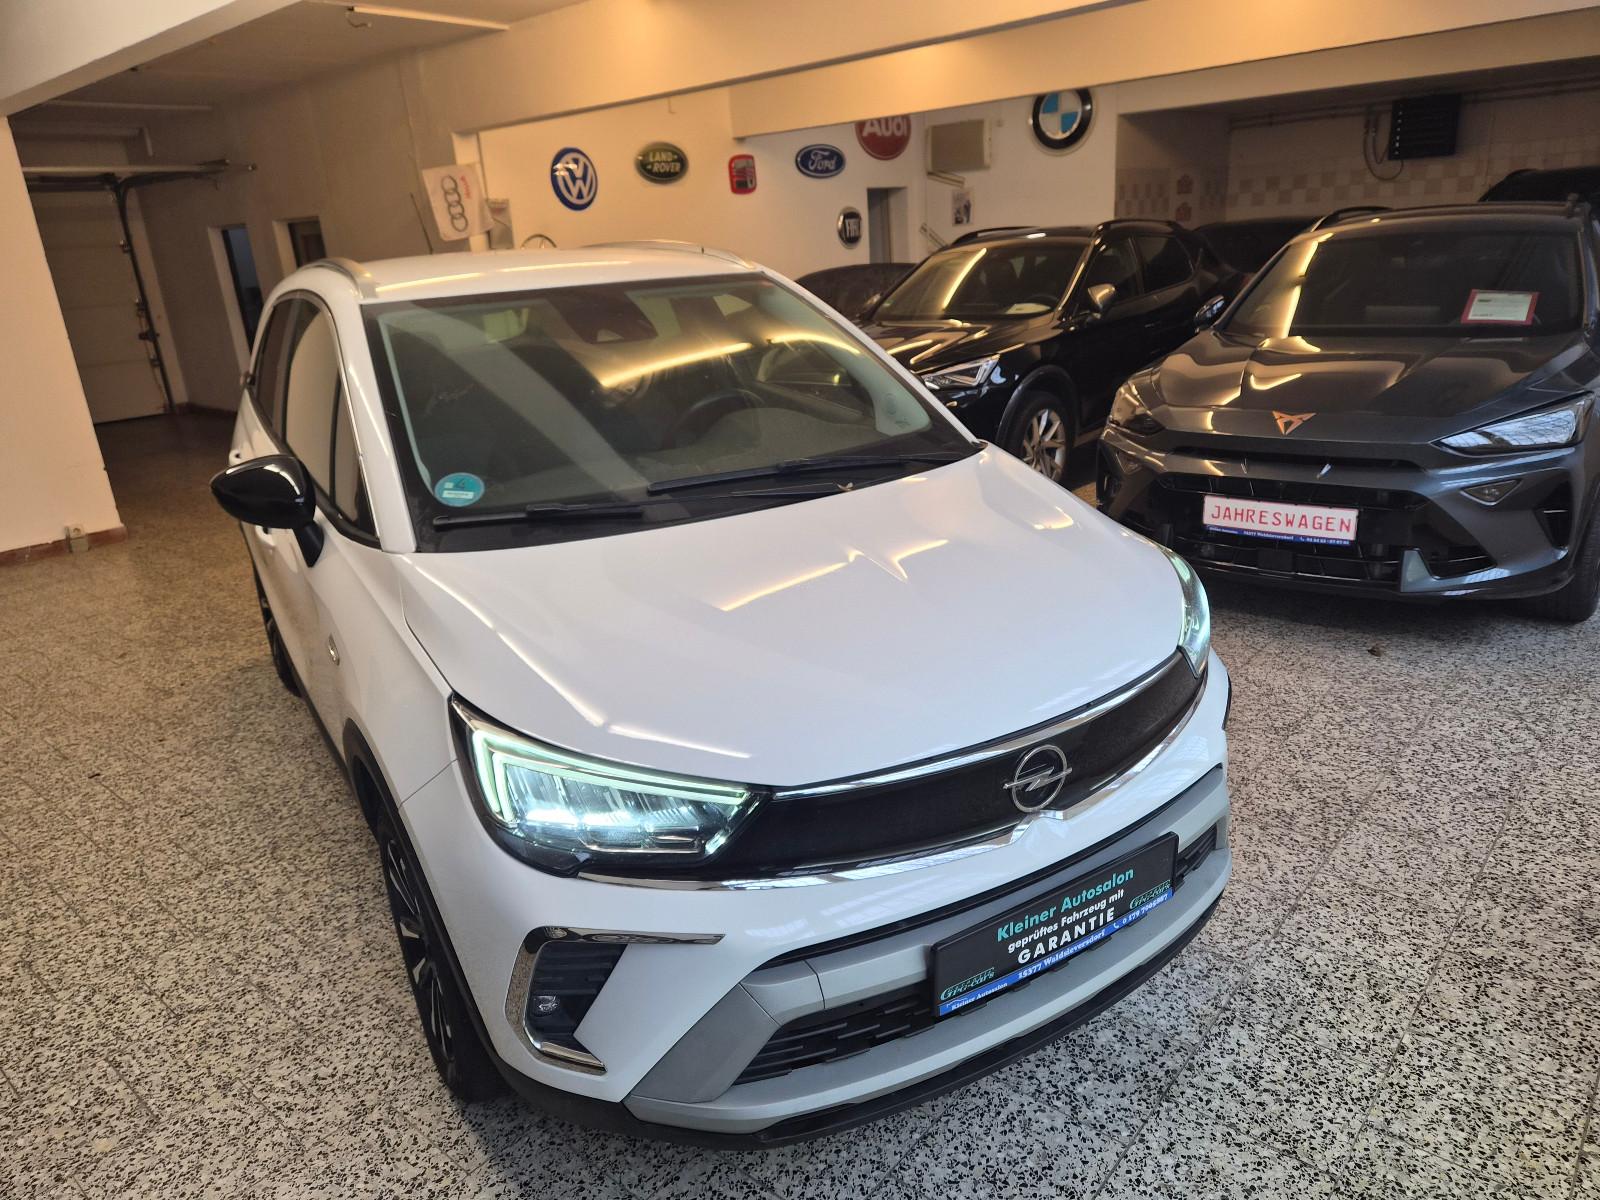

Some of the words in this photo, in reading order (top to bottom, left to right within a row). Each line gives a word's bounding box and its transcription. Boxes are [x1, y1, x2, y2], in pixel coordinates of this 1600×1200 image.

[650, 150, 674, 162] LAND
[652, 162, 681, 173] ROVER
[808, 150, 838, 171] Ford
[1211, 505, 1351, 533] JAHRESWAGEN
[996, 905, 1057, 942] Kleiner
[1060, 868, 1135, 913] Autosalon
[1007, 923, 1059, 954] geprüftes
[1061, 900, 1107, 926] Fahrzeug
[1109, 888, 1125, 905] mit
[1017, 906, 1115, 964] GARANTIE
[1017, 963, 1042, 979] 15377
[1043, 929, 1106, 966] Waldsieversdorf
